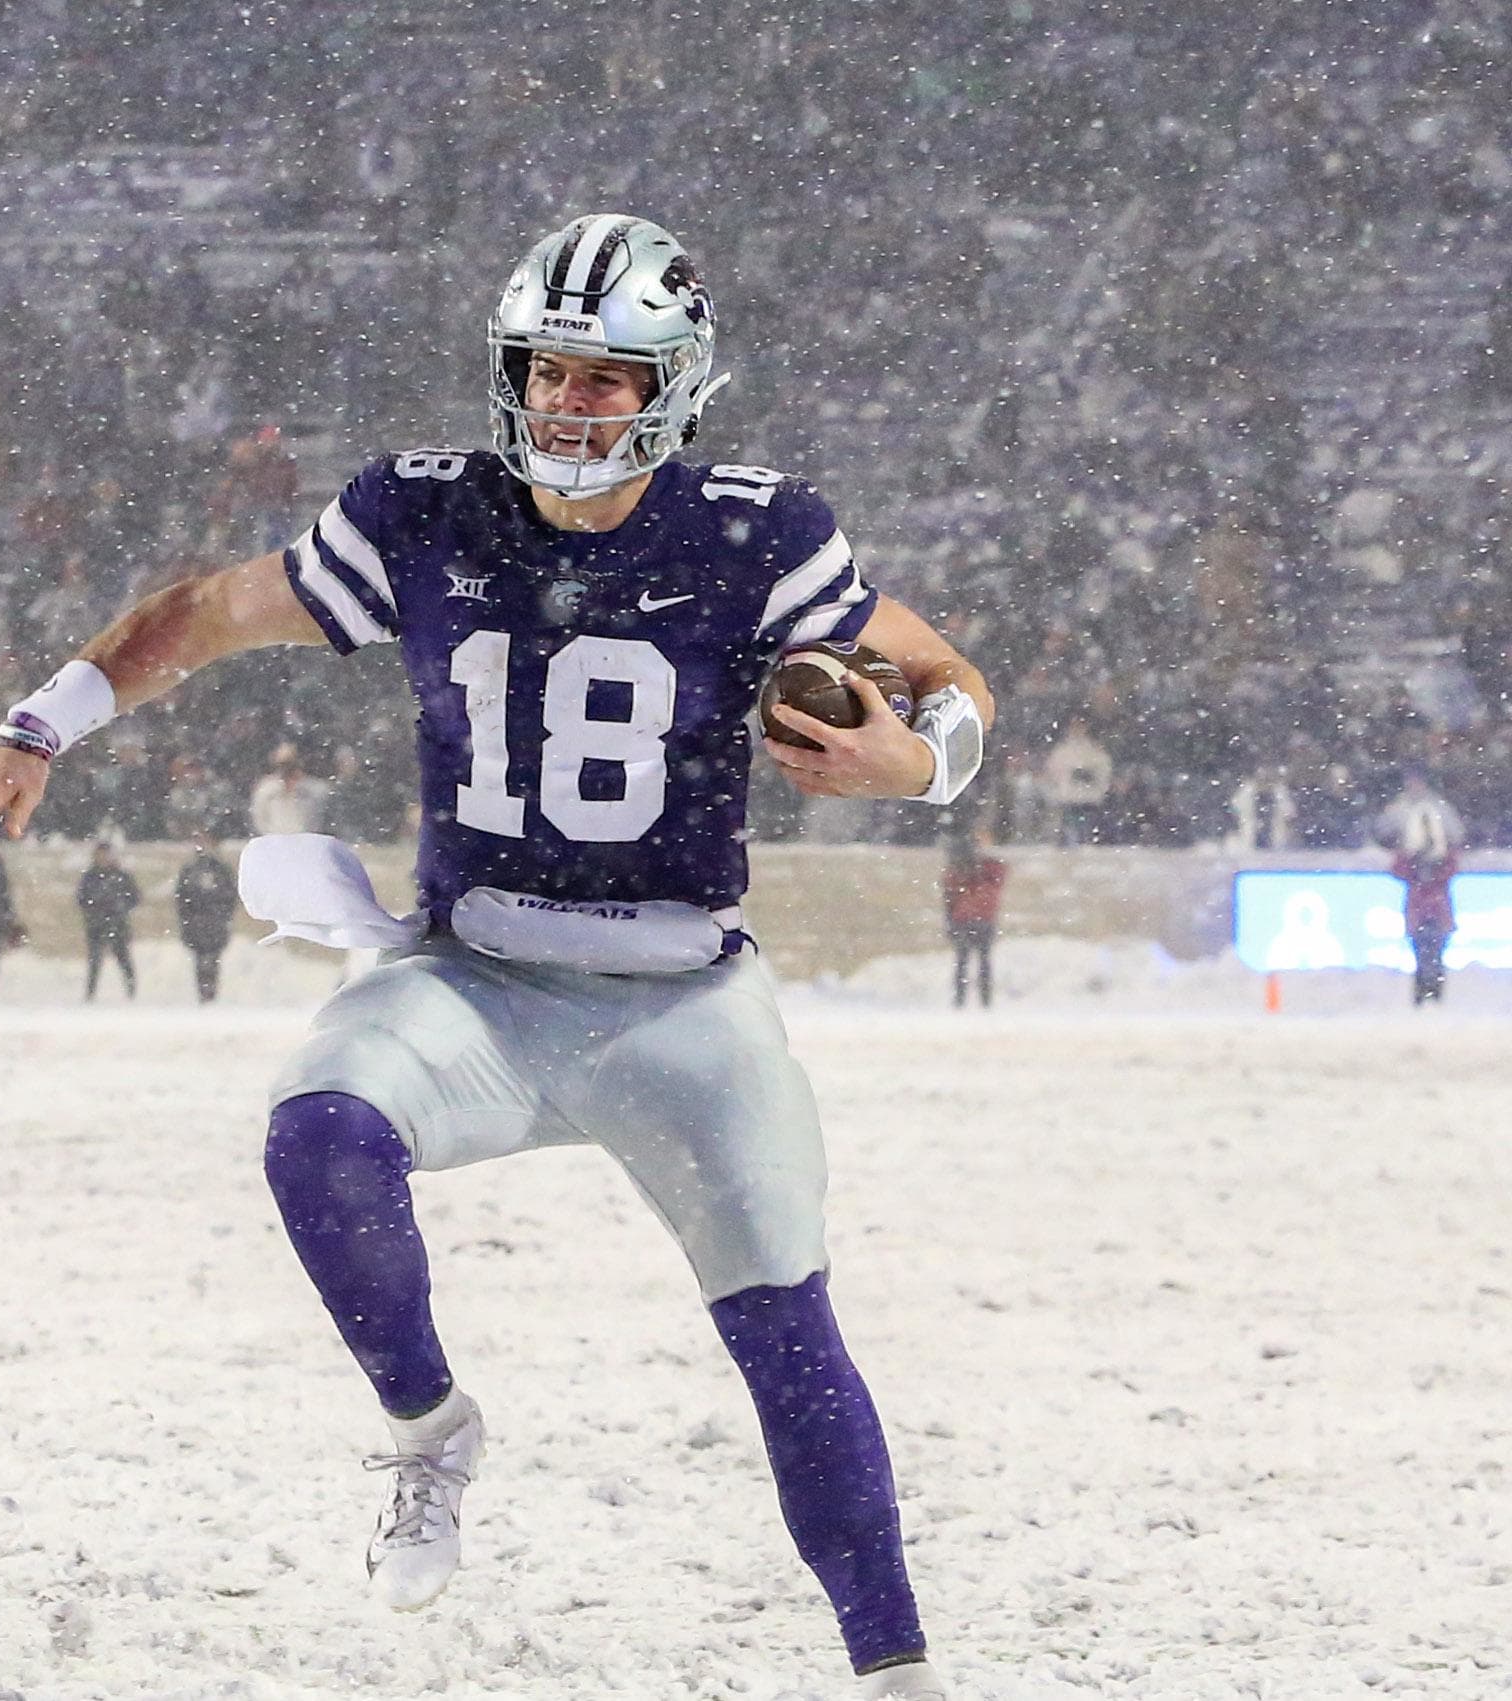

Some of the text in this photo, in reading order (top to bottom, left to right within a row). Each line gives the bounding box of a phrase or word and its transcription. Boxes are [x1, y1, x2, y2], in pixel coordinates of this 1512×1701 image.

[541, 317, 593, 332] K-STATE
[701, 464, 785, 507] 18
[445, 573, 491, 602] XII
[450, 629, 678, 843] 18
[517, 898, 639, 920] WILATS
